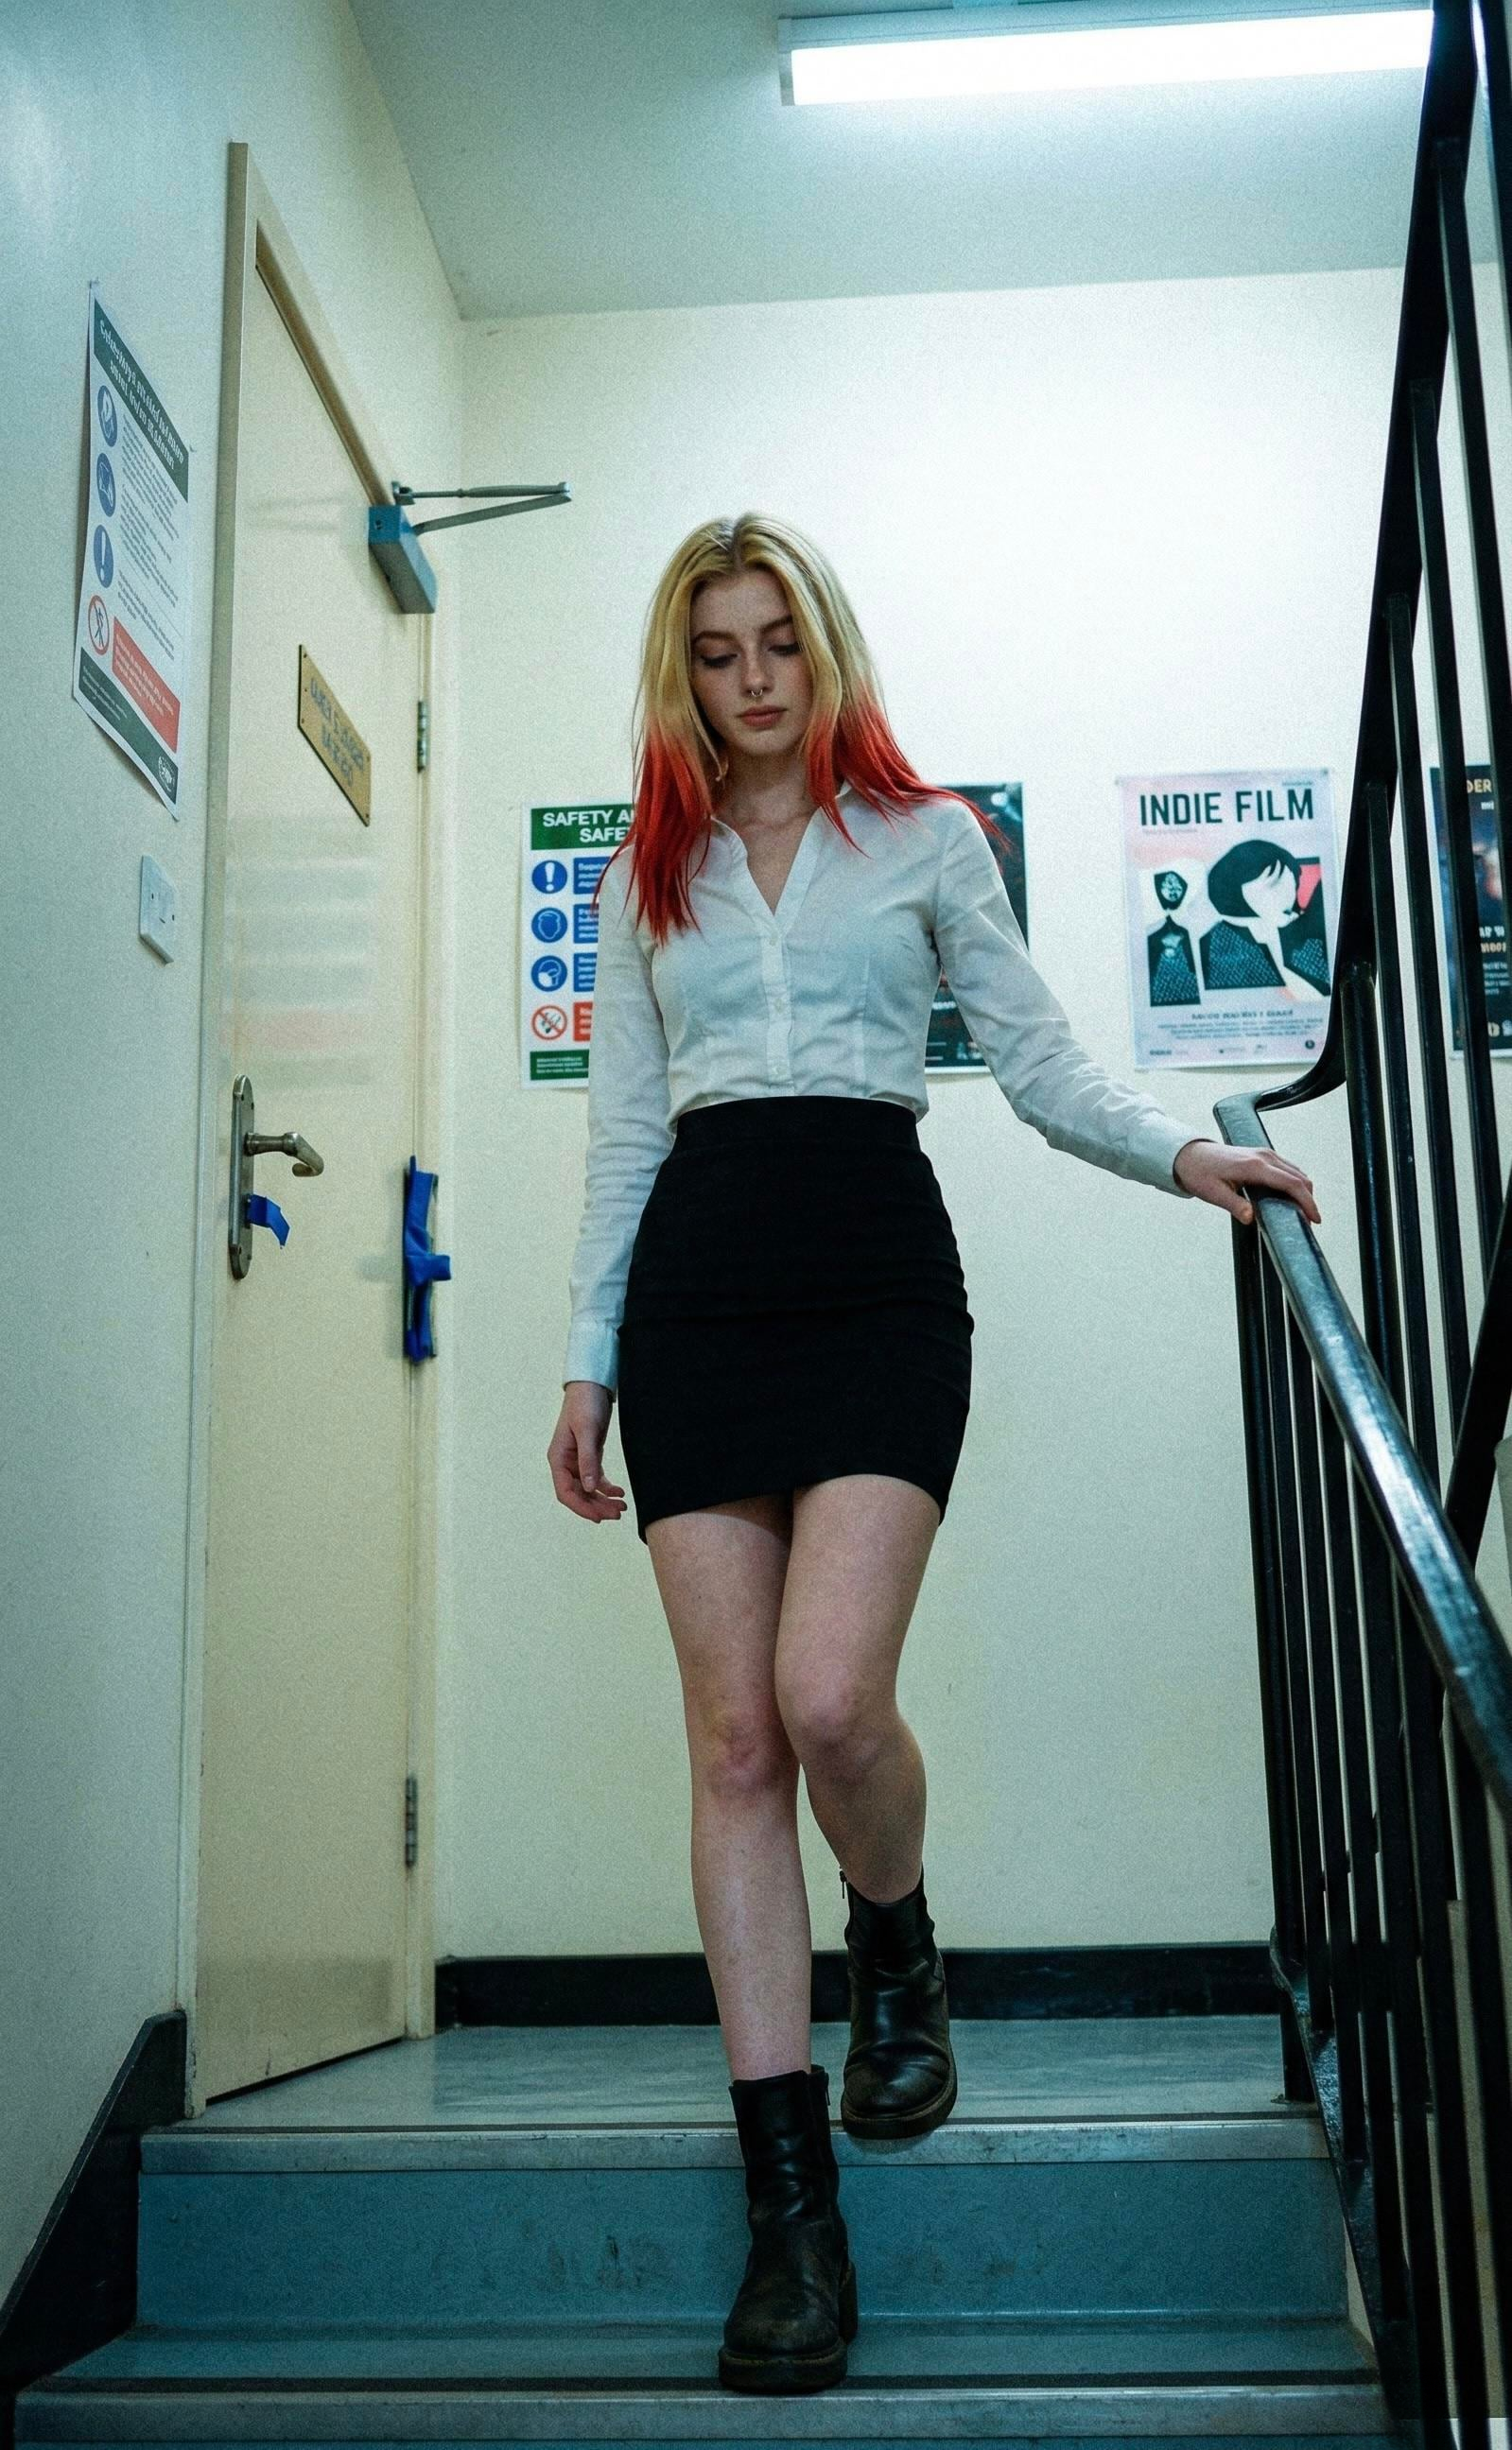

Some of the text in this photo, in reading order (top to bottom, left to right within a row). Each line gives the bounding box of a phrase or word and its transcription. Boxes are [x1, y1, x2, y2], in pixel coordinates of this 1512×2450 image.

[1139, 789, 1313, 826] INDIE FILM
[543, 809, 614, 827] SAFETY
[580, 826, 630, 843] SAFE
